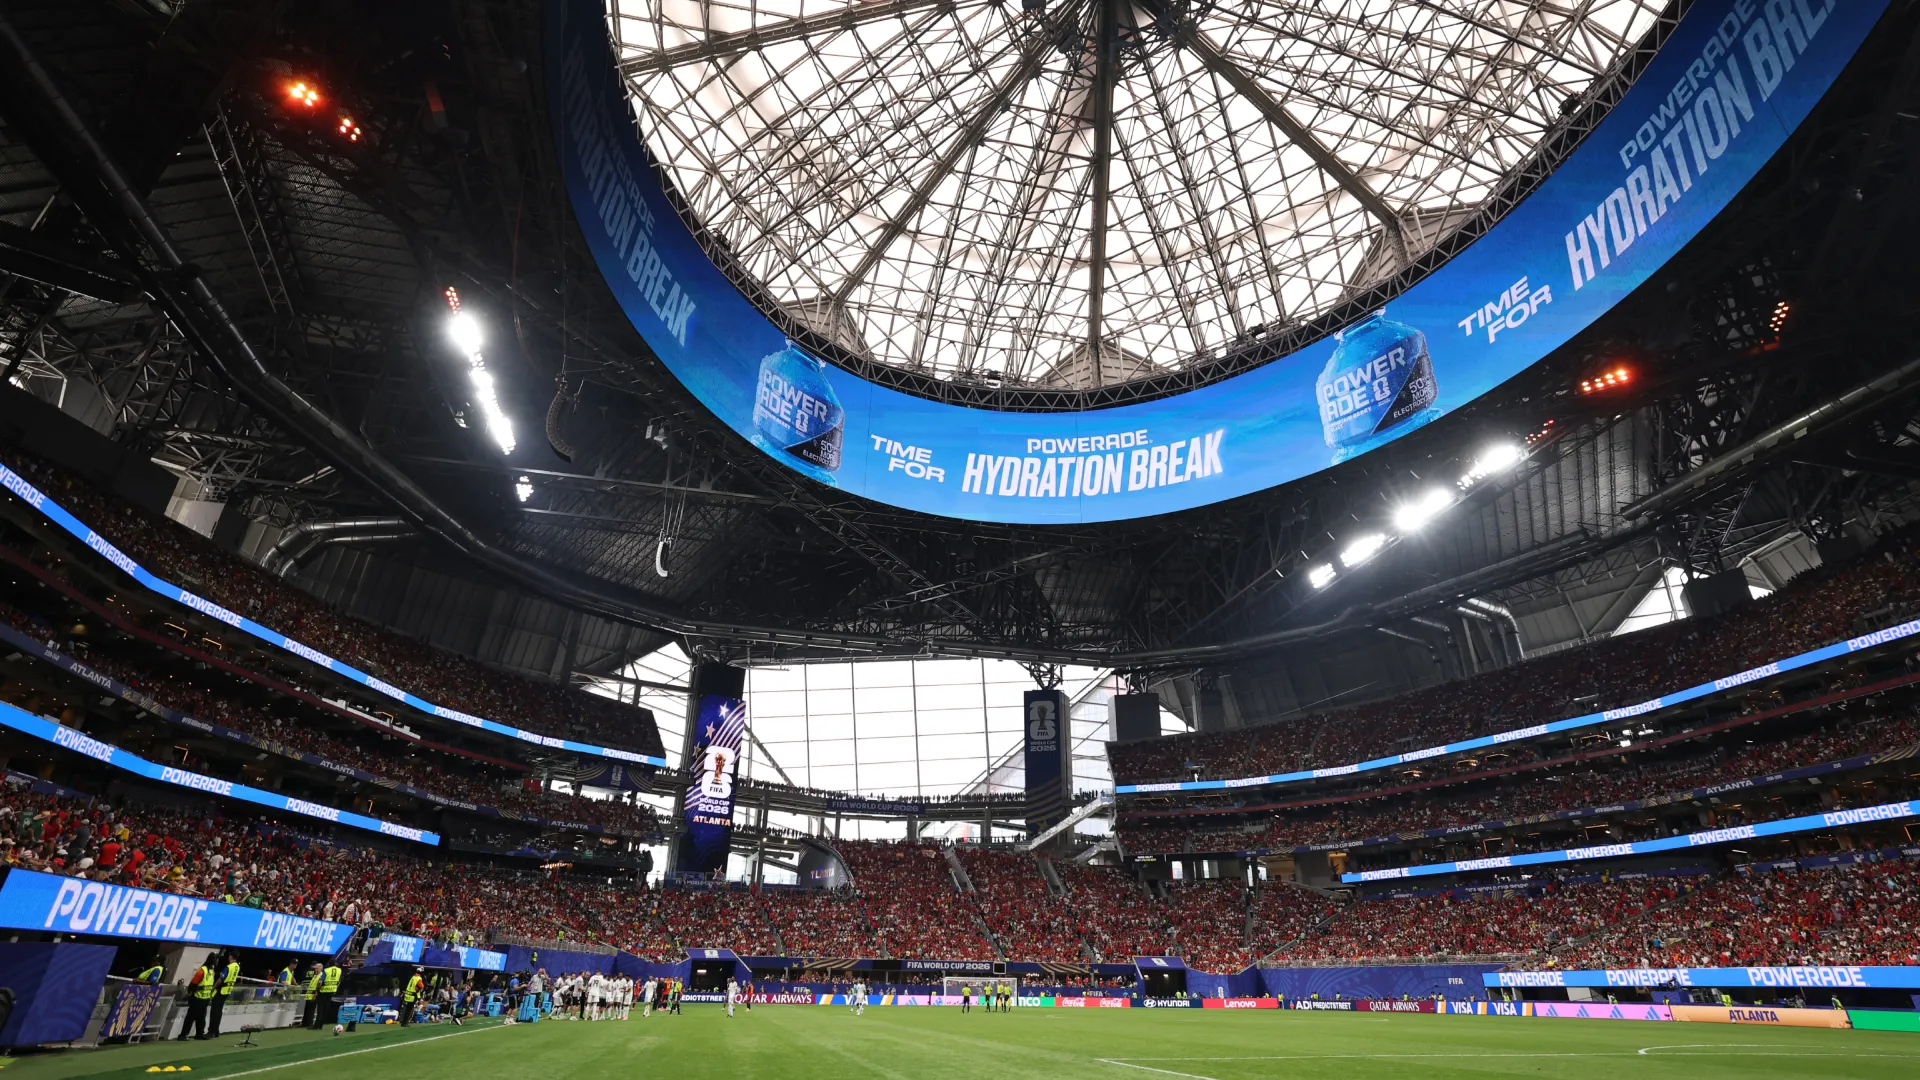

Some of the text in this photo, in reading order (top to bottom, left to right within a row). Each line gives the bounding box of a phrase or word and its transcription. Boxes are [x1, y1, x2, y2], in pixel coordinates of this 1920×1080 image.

[1619, 0, 1757, 170] POWERADE
[1564, 0, 1836, 292] HYDRATION BRE
[626, 232, 696, 347] BREAK
[1457, 276, 1530, 336] TIME
[1486, 283, 1553, 343] FOR
[1323, 346, 1407, 403] POWER
[761, 386, 793, 422] ADE
[763, 369, 828, 422] POWER
[1326, 386, 1370, 422] ADE
[870, 434, 932, 464] TIME
[1027, 430, 1149, 454] POWERADE
[888, 456, 945, 483] FOR
[962, 429, 1224, 497] HYDRATION BREAK
[86, 530, 137, 575] POWERADE
[179, 591, 242, 627] POWERADE
[284, 638, 333, 668] POWERADE
[70, 662, 112, 689] ATLANTA
[1715, 663, 1780, 690] POWERADE
[366, 676, 406, 701] POWERADE
[434, 706, 483, 727] POWERADE
[1603, 698, 1663, 720] POWERADE
[1493, 724, 1547, 743] POWERADE
[53, 727, 114, 761] POWERADE
[602, 748, 649, 764] POWERADE
[320, 760, 355, 776] ATLANTA
[1313, 763, 1359, 778] POWERADE
[161, 766, 232, 796] POWERADE
[709, 786, 723, 794] FIFA
[1136, 782, 1182, 793] POWERADE
[1225, 775, 1270, 788] POWERADE
[1706, 779, 1754, 795] ATLANTA
[286, 797, 339, 821] POWERADE
[698, 804, 729, 815] 2026
[700, 797, 718, 806] WORLD
[832, 801, 919, 812] FIFA WORLD CUP 2026
[693, 815, 731, 827] ATLANTA
[1824, 801, 1913, 827] POWERADE
[380, 821, 422, 842] POWERADE
[551, 820, 589, 830] ATLANTA
[1446, 824, 1484, 834] ATLANTA
[1688, 824, 1756, 846] POWERADE
[1566, 844, 1634, 860] POWERADE
[1456, 857, 1511, 872] POWERADE
[45, 877, 208, 940] POWERADE
[254, 911, 337, 952] POWERADE
[924, 962, 949, 970] WORLD
[951, 962, 965, 970] CUP
[966, 962, 990, 970] 2026
[1448, 977, 1464, 985] FIFA
[1499, 971, 1564, 986] POWERADE
[1747, 967, 1867, 986] POWERADE
[681, 994, 726, 1002] EDICTSTREET
[771, 994, 812, 1004] AIRWAYS
[1157, 1000, 1190, 1008] HYUNDAI
[1224, 999, 1256, 1008] Lenovo
[1296, 1001, 1351, 1010] ADI PREDICTSTREET
[1370, 1001, 1420, 1012] QATAR AIRWAYS
[1450, 1002, 1474, 1014] VISA
[1492, 1003, 1518, 1015] VISA
[1729, 1009, 1779, 1022] ATLANTA
